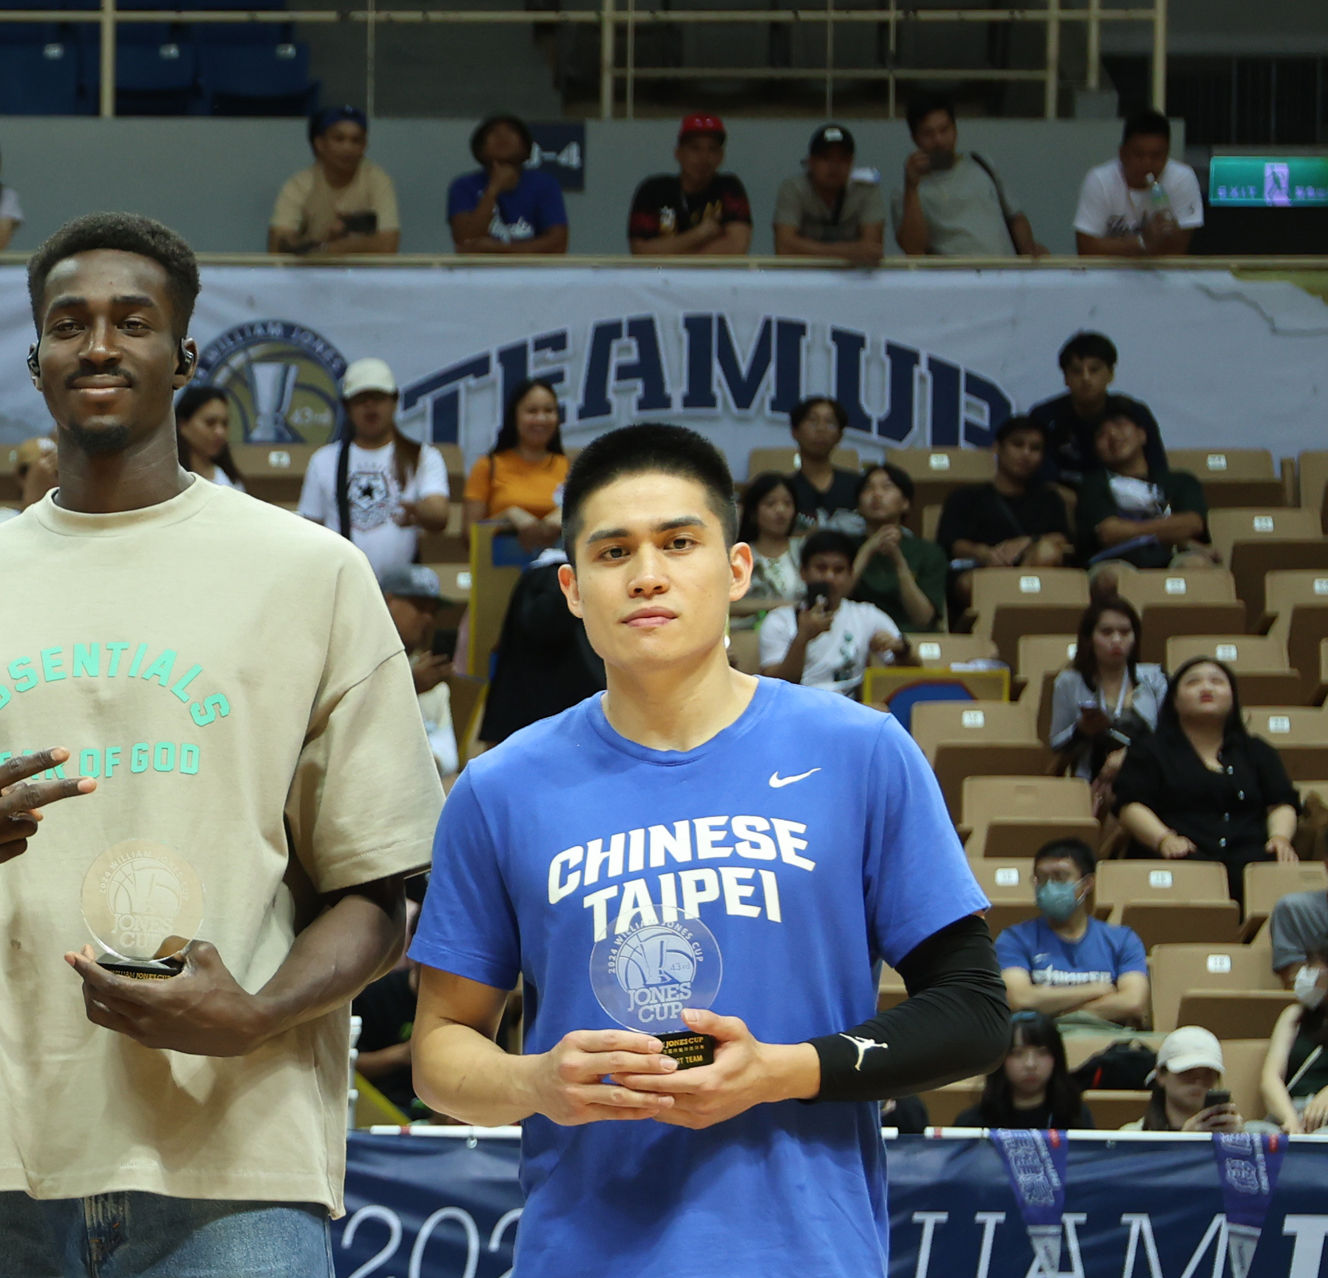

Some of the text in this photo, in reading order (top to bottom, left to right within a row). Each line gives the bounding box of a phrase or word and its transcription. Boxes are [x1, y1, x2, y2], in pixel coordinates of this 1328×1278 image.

[78, 746, 122, 778] OF
[130, 742, 200, 775] GOD
[547, 815, 817, 905] CHINESE
[582, 869, 782, 943] TAIPEI
[607, 949, 619, 975] 2024
[661, 921, 692, 941] JONES
[692, 942, 704, 962] CUP
[626, 982, 692, 1012] JONES
[638, 1001, 684, 1023] CUP
[665, 1036, 704, 1049] JONES CUP
